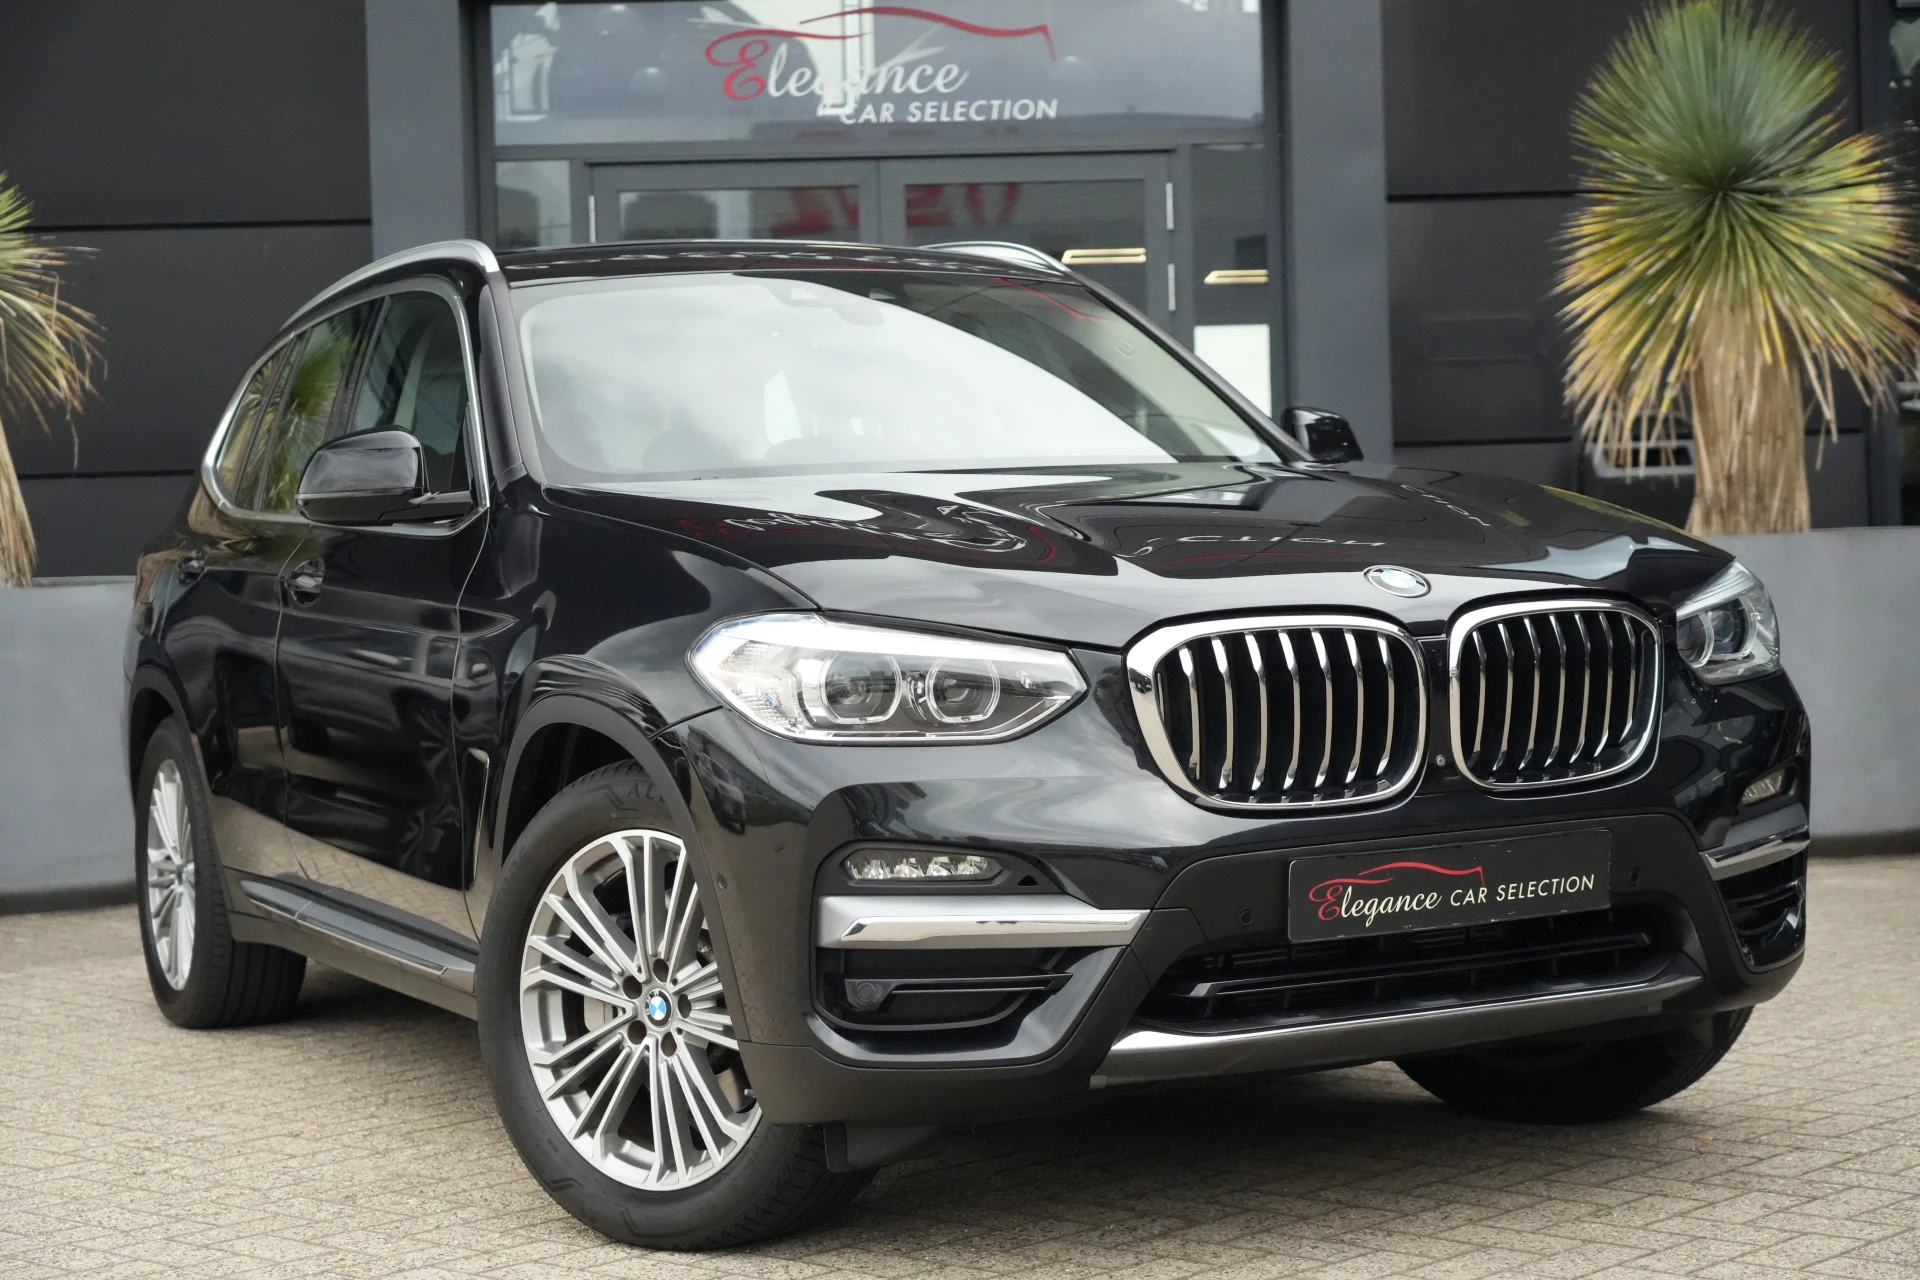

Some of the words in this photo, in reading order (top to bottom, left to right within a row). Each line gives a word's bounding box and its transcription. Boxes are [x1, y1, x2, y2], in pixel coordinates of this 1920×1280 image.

[906, 98, 1058, 123] SELECTION
[1308, 878, 1443, 927] Elegance
[1450, 887, 1487, 907] CAR
[1496, 873, 1595, 902] SELECTION
